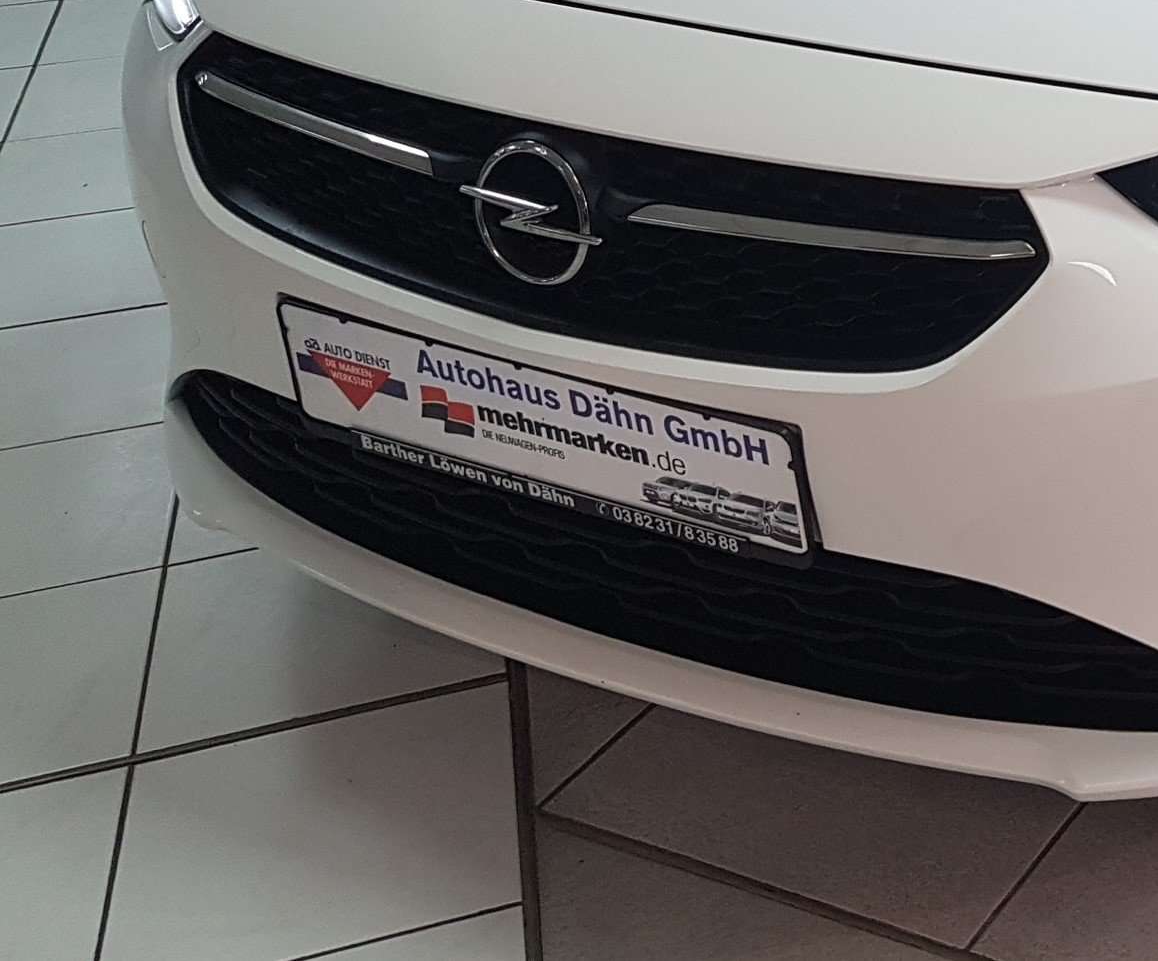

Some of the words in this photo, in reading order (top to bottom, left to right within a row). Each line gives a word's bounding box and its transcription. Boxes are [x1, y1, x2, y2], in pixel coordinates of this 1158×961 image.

[324, 343, 352, 359] AUTO
[355, 350, 391, 370] DIENST
[331, 371, 374, 388] WERKSTATT
[417, 349, 561, 411] Autohaus
[568, 388, 654, 436] Dähn
[663, 414, 770, 466] GmbH
[477, 405, 687, 476] mehrmarken.de
[481, 429, 493, 440] DIE
[495, 433, 566, 461] NEUWAGEN-PROFIS
[361, 435, 425, 465] Barther
[429, 453, 487, 484] Löwen
[491, 473, 524, 494] von
[527, 482, 575, 508] Dähn
